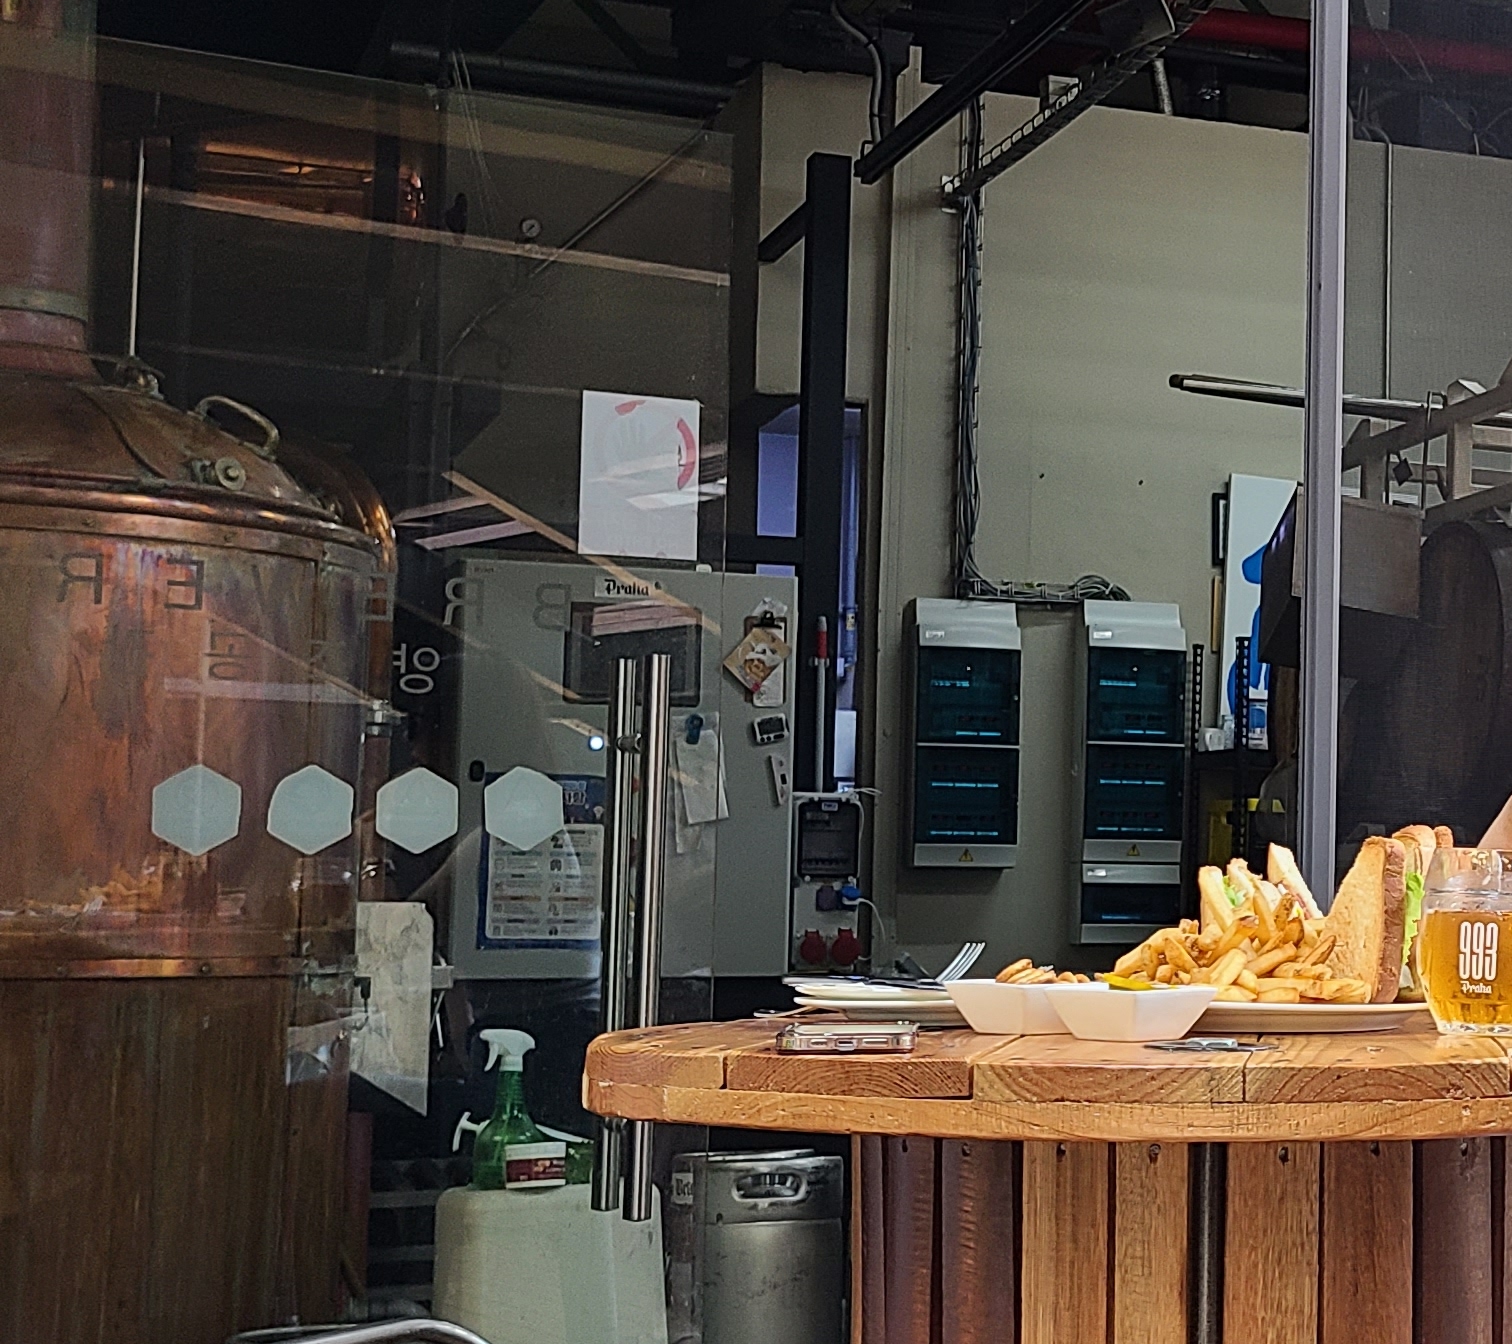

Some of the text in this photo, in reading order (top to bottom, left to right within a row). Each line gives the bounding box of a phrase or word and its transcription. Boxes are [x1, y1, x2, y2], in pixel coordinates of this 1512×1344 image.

[604, 578, 649, 596] Praha
[1459, 921, 1499, 981] 993
[1460, 980, 1492, 994] Praha
